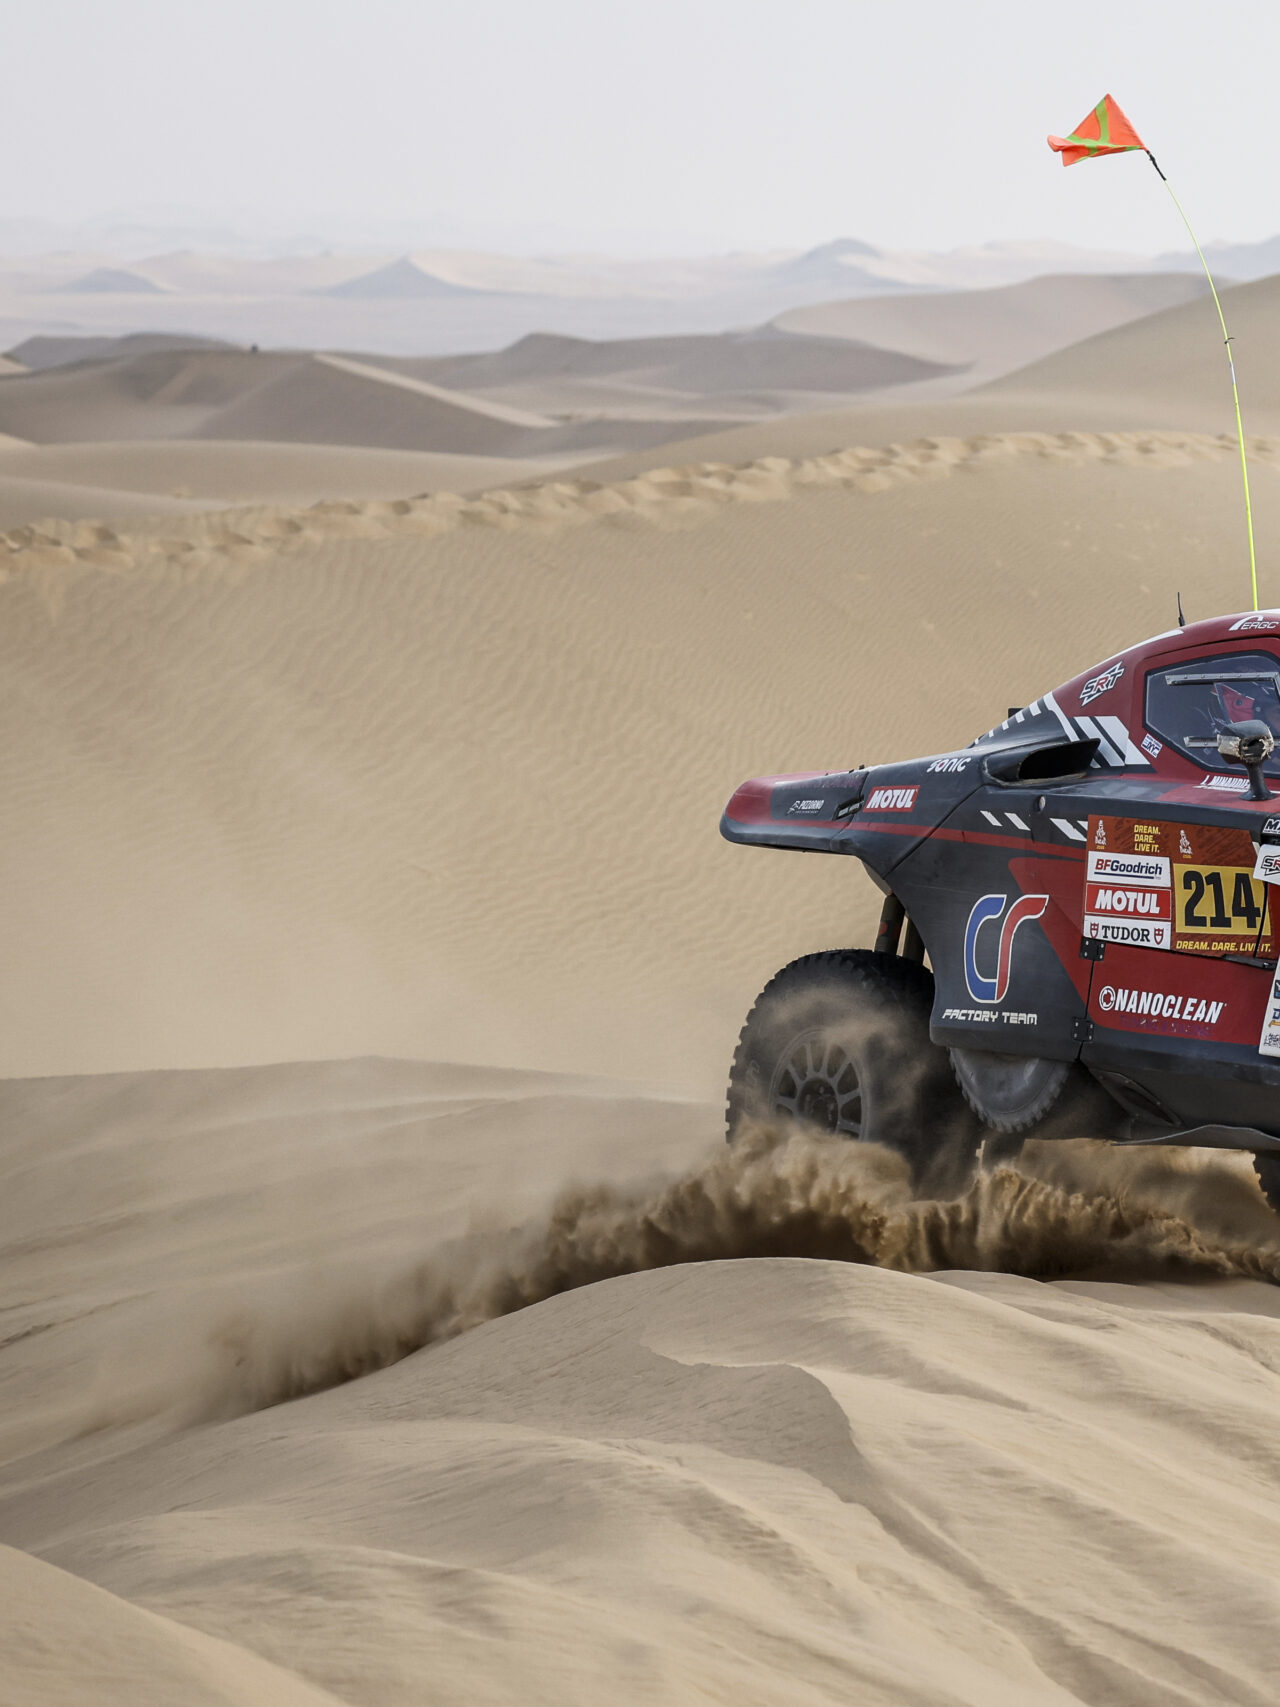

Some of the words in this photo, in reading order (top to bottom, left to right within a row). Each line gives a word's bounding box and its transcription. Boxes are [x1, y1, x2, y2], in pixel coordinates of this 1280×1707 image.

[1079, 666, 1125, 699] SRT
[866, 788, 916, 810] MOTUL
[1133, 824, 1161, 834] DREAM.
[1134, 834, 1156, 843] DARE.
[1134, 843, 1151, 853] LIVE
[1151, 844, 1160, 853] IT.
[1095, 858, 1163, 876] BFGoodrich
[1094, 888, 1161, 915] MOTUL
[1182, 869, 1262, 929] 214
[1101, 924, 1152, 943] TUDOR
[1176, 940, 1210, 951] DREAM.
[1211, 941, 1238, 952] DARE.
[1260, 943, 1272, 953] IT.
[1114, 988, 1224, 1024] NANOCLEAN
[942, 1009, 1000, 1024] FACTORY
[1002, 1012, 1038, 1026] TEAM
